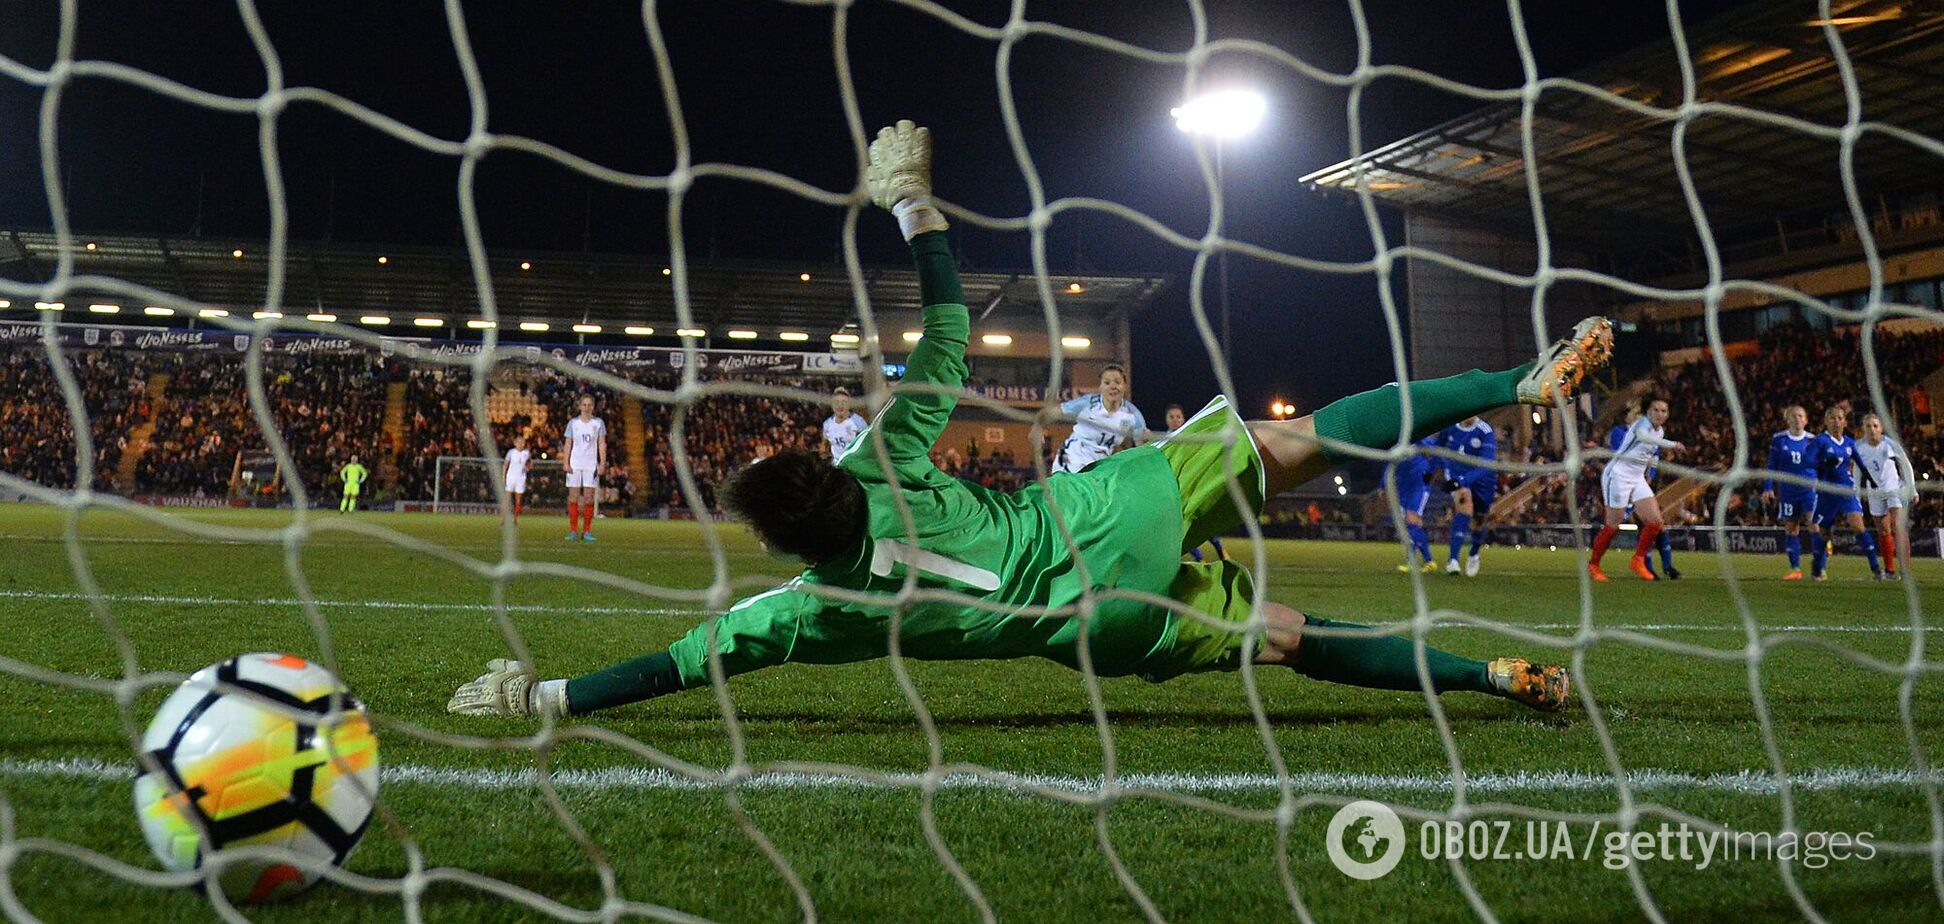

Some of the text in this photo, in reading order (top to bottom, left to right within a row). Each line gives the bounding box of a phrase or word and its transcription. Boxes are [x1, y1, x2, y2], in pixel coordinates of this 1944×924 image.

[582, 434, 592, 444] 10
[1098, 432, 1116, 449] 14
[1791, 450, 1802, 465] 13
[1872, 459, 1881, 472] 3
[1783, 502, 1794, 517] 13
